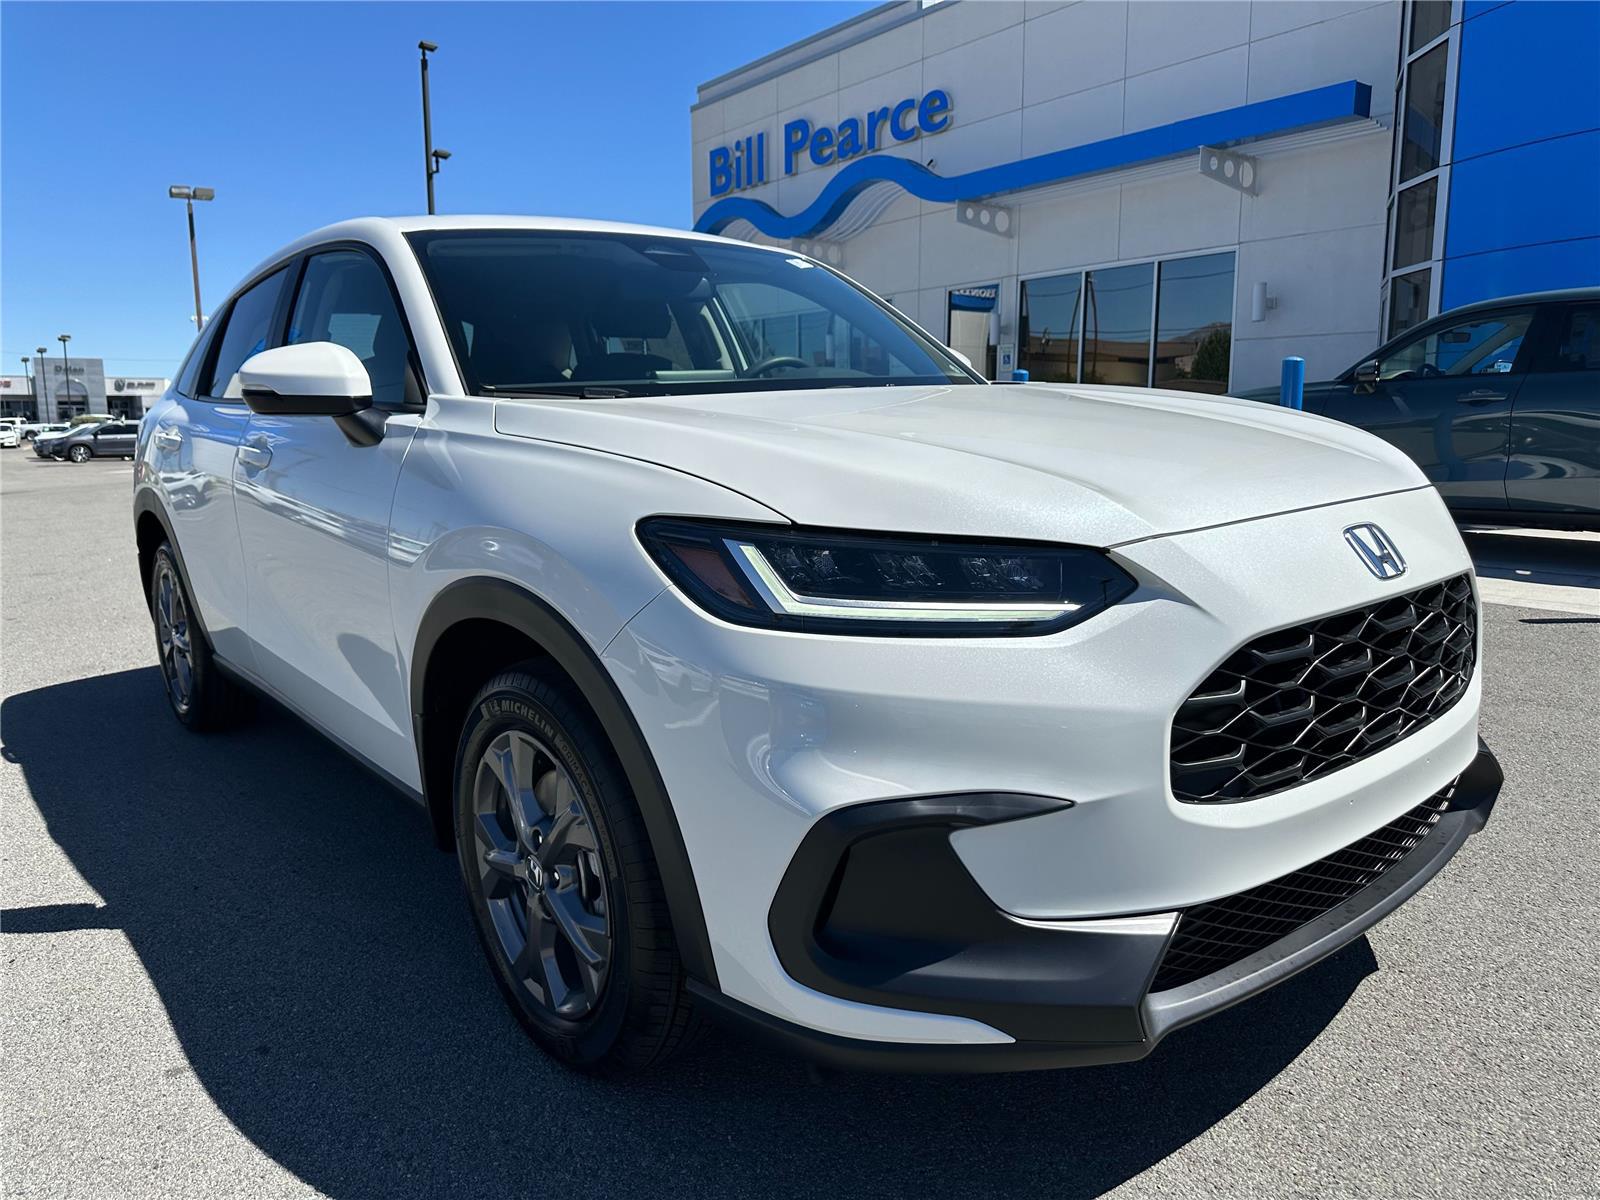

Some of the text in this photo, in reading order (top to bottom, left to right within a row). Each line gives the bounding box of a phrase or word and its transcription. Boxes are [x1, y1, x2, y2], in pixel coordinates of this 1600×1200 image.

[709, 89, 950, 197] Bill Pearce
[502, 699, 554, 738] MICHELIN
